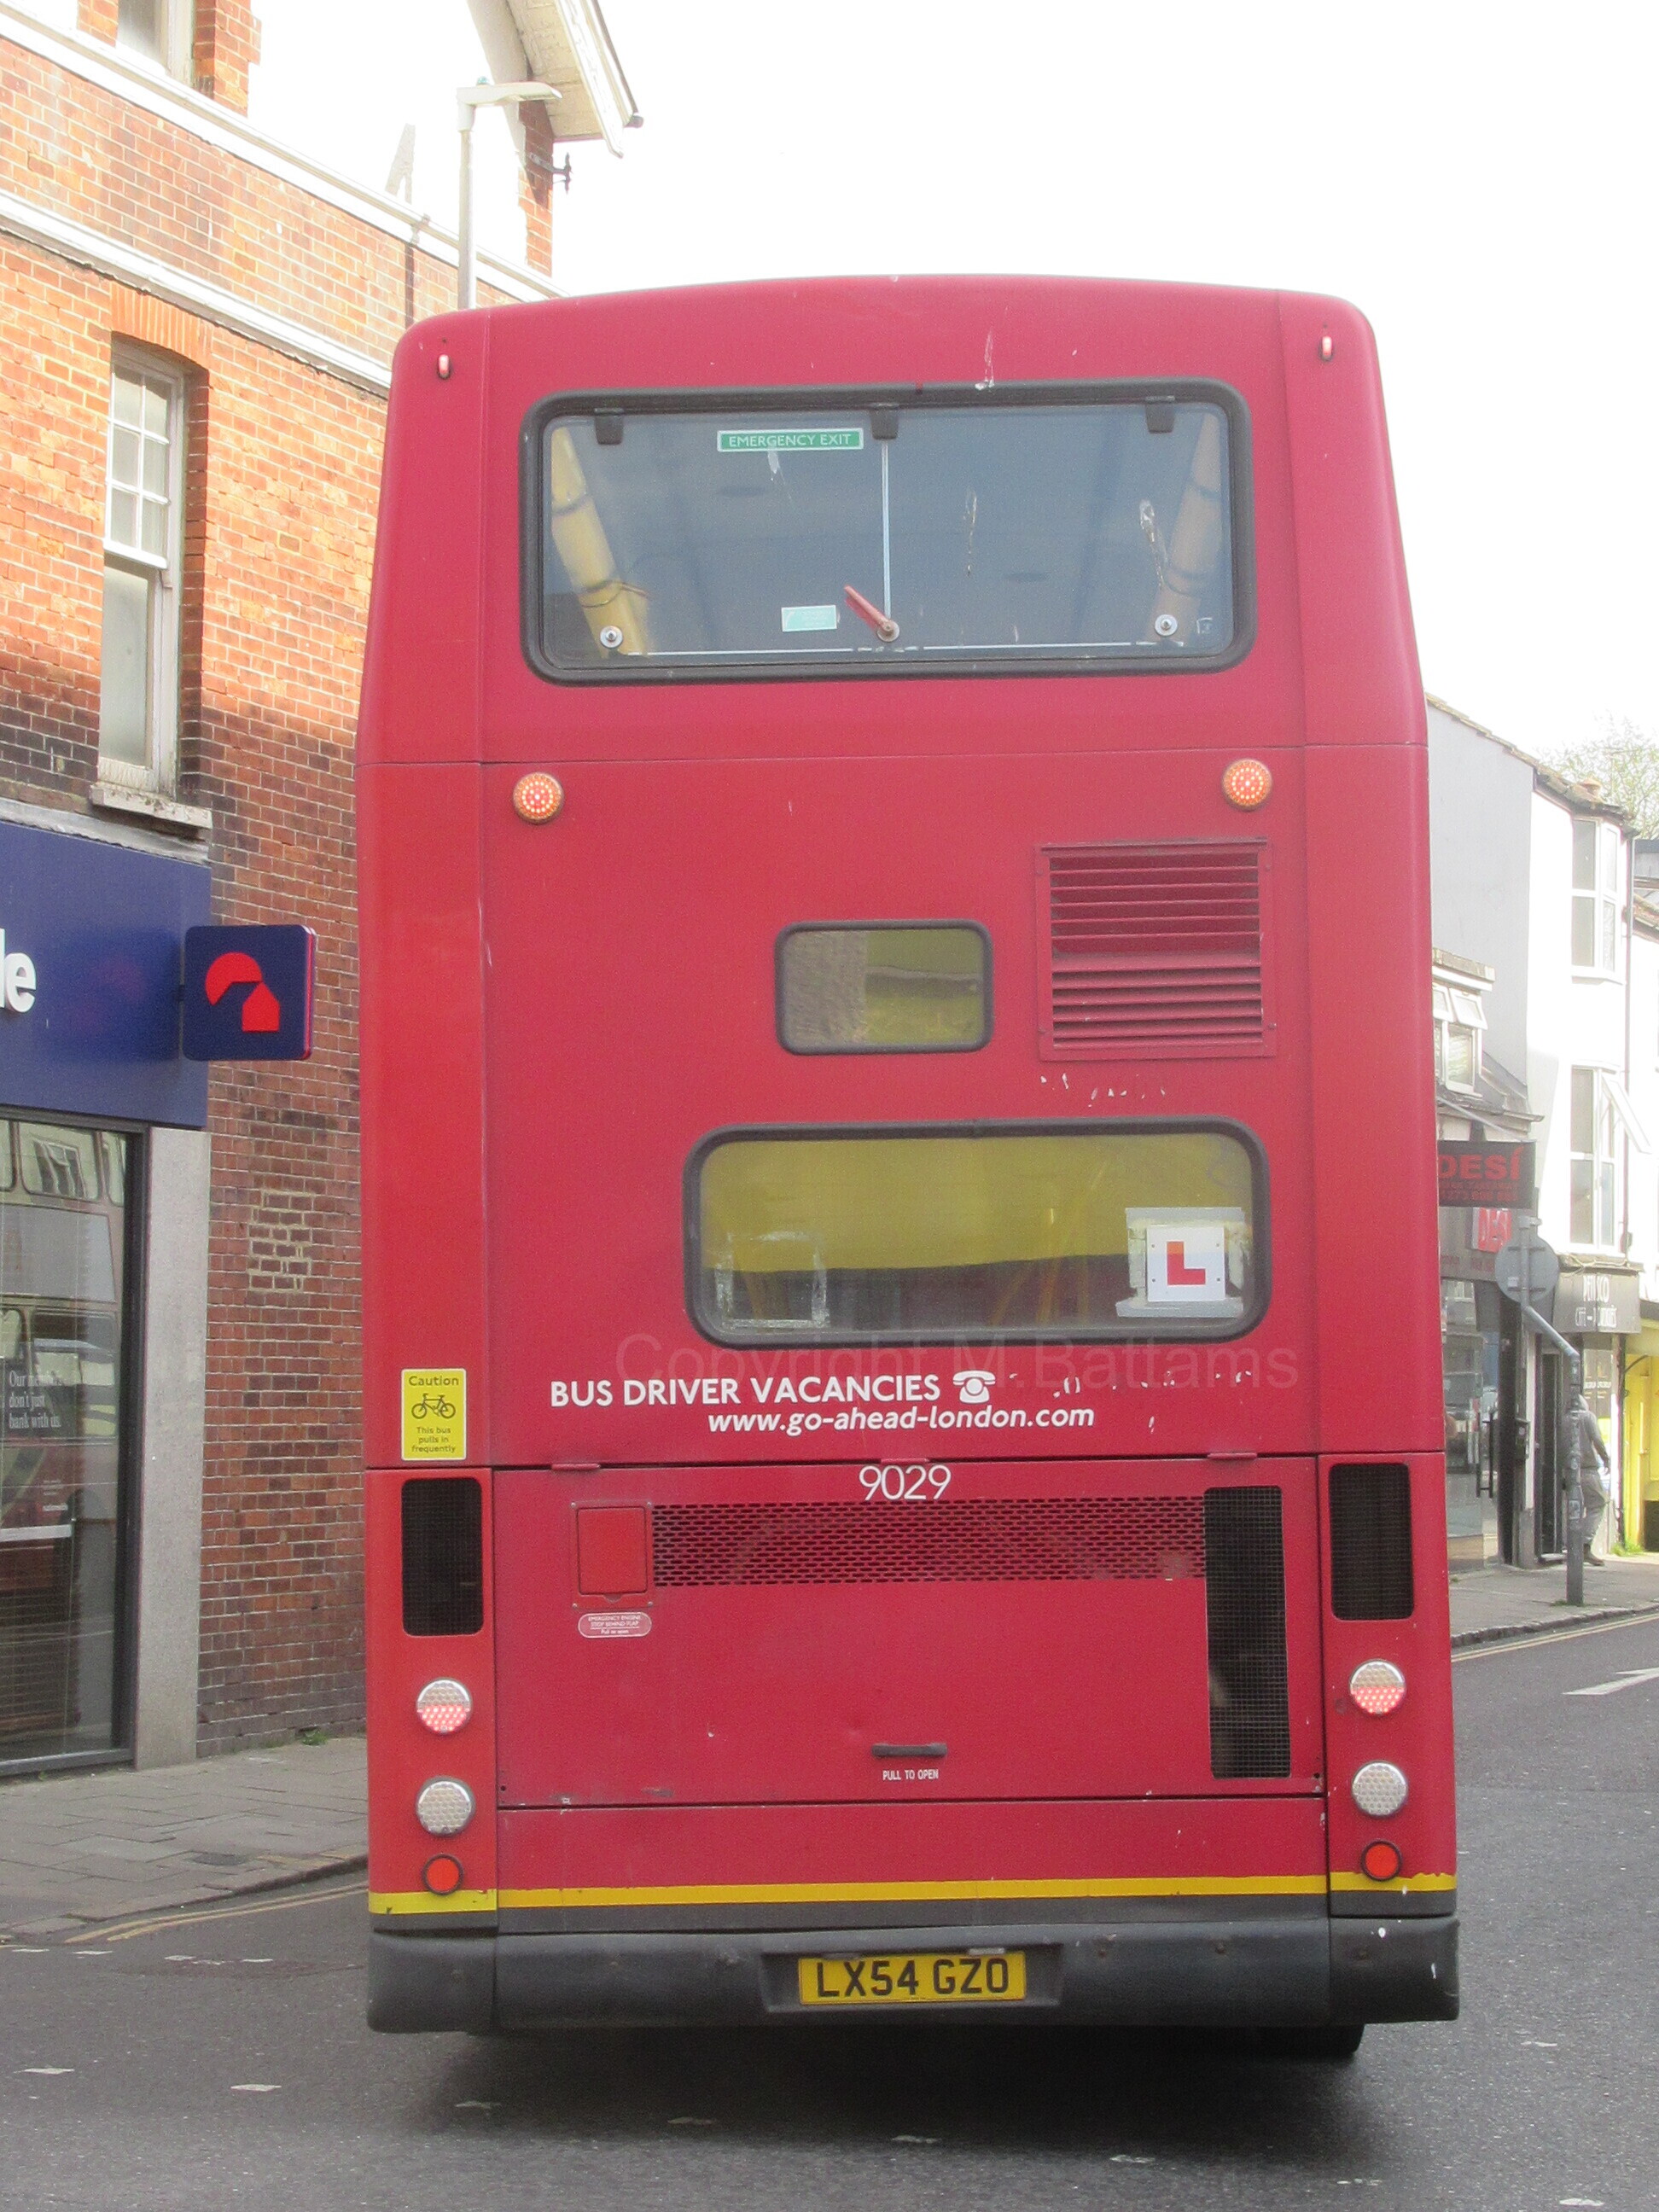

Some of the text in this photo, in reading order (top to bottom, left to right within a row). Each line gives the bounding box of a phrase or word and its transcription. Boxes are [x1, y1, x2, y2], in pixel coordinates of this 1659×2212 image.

[729, 434, 851, 447] EMERGENCY EXIT
[1167, 1242, 1206, 1285] L
[409, 1375, 459, 1386] Caution
[550, 1375, 940, 1407] BUS DRIVER VACANCIES
[708, 1406, 1095, 1437] www.go-ahead-london.com
[411, 1445, 456, 1453] frequently
[859, 1464, 952, 1501] 9029
[882, 1768, 939, 1780] PULL TO OPEN
[817, 1958, 1010, 1998] LX54 GZO
